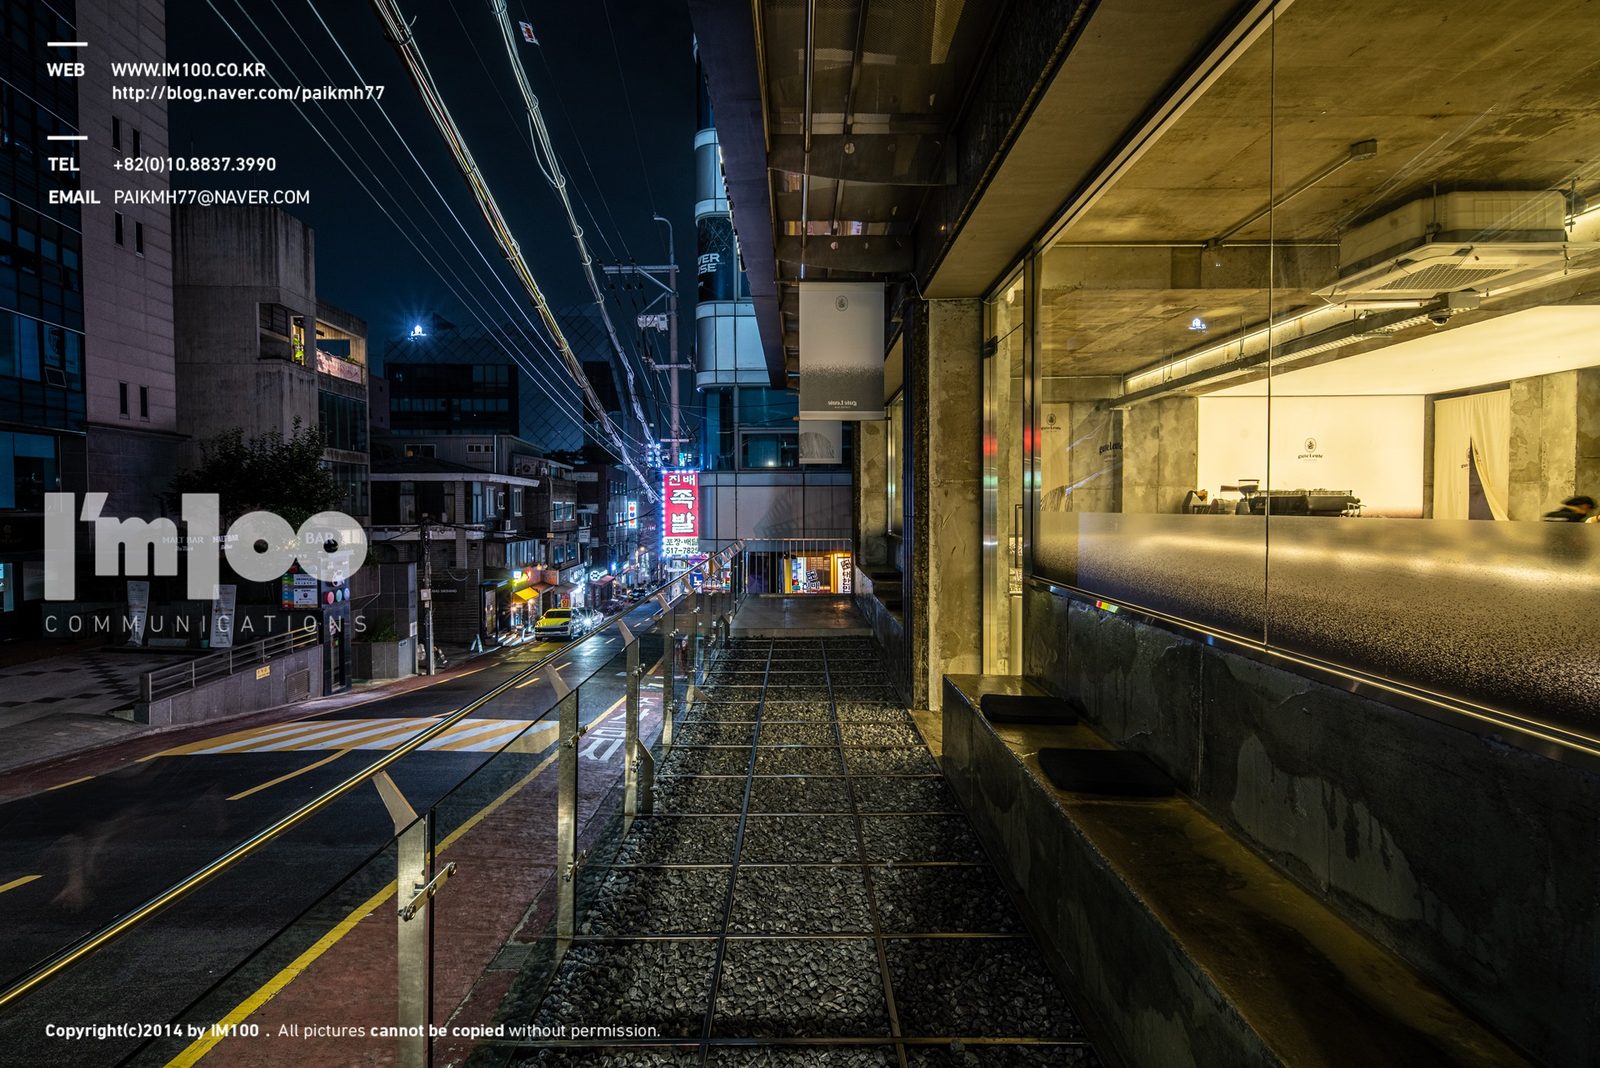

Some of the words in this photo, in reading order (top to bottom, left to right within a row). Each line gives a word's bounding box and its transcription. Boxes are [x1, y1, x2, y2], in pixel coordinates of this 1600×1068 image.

[669, 474, 696, 487] 진배
[669, 489, 696, 534] 족발
[304, 531, 334, 545] BAR
